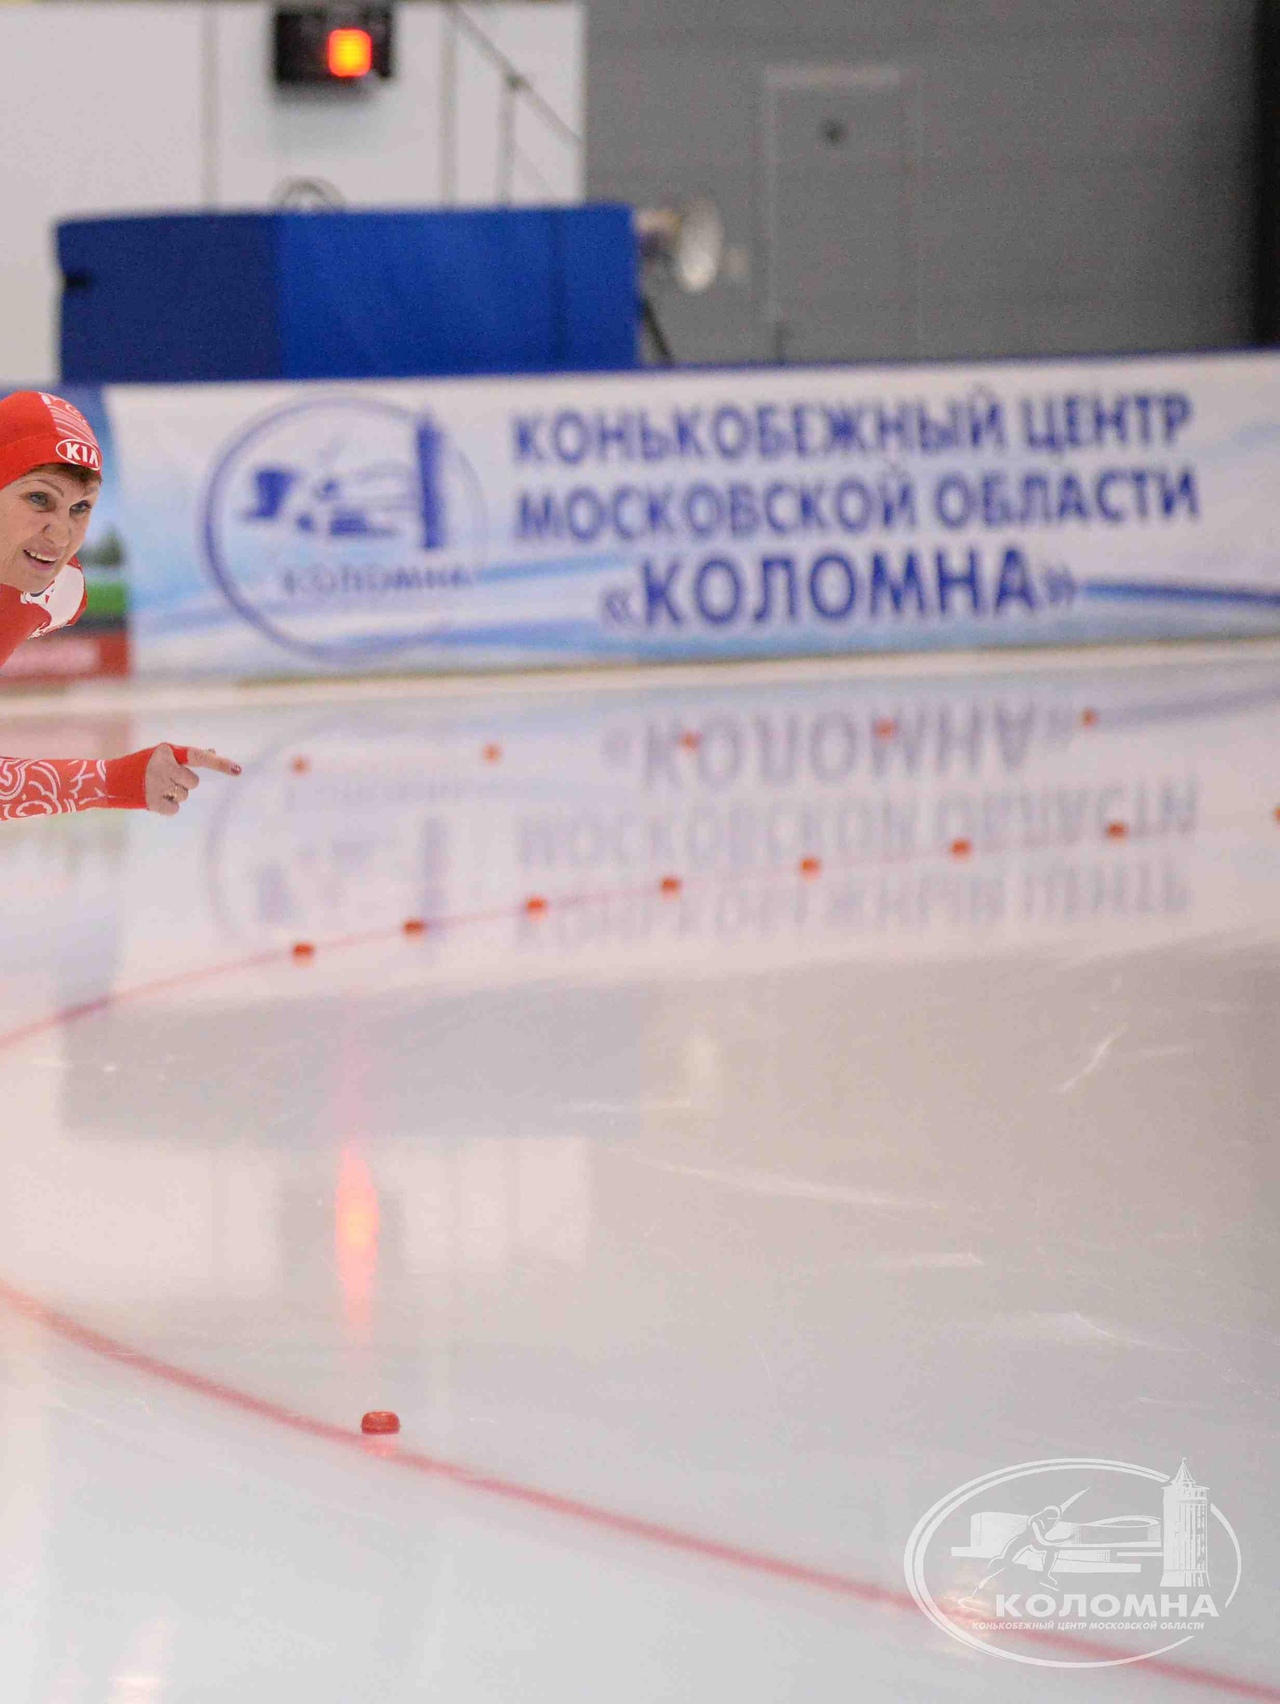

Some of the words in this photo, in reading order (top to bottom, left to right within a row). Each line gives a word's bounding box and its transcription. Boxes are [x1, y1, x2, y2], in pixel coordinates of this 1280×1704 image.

[65, 442, 99, 468] KIA
[513, 384, 1005, 464] КОНЬКОБЕЖНЫЙ
[1023, 392, 1193, 456] ЦЕНТР
[519, 463, 917, 541] МОСКОВСКОЙ
[934, 465, 1198, 529] ОБЛАСТИ
[602, 548, 1077, 628] «КОЛОМНА»
